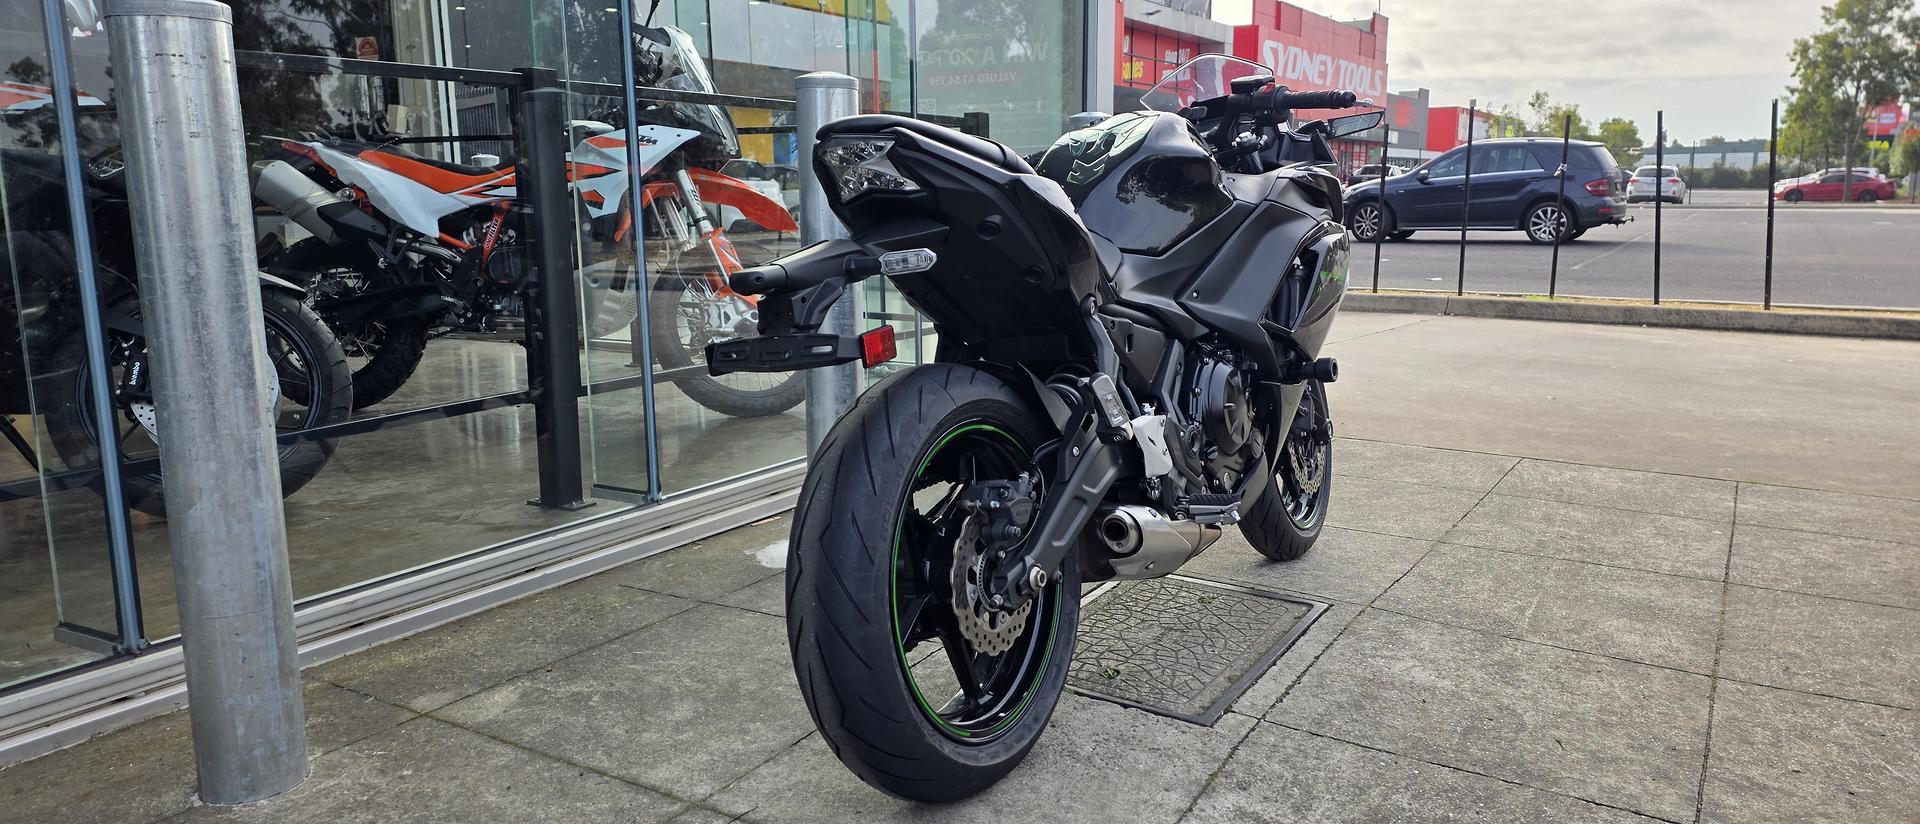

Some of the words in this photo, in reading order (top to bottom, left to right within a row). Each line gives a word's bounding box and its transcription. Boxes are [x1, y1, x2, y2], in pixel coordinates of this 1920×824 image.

[1263, 39, 1338, 87] SYDNEY
[1340, 59, 1383, 96] TOOLS
[129, 361, 141, 385] brembo
